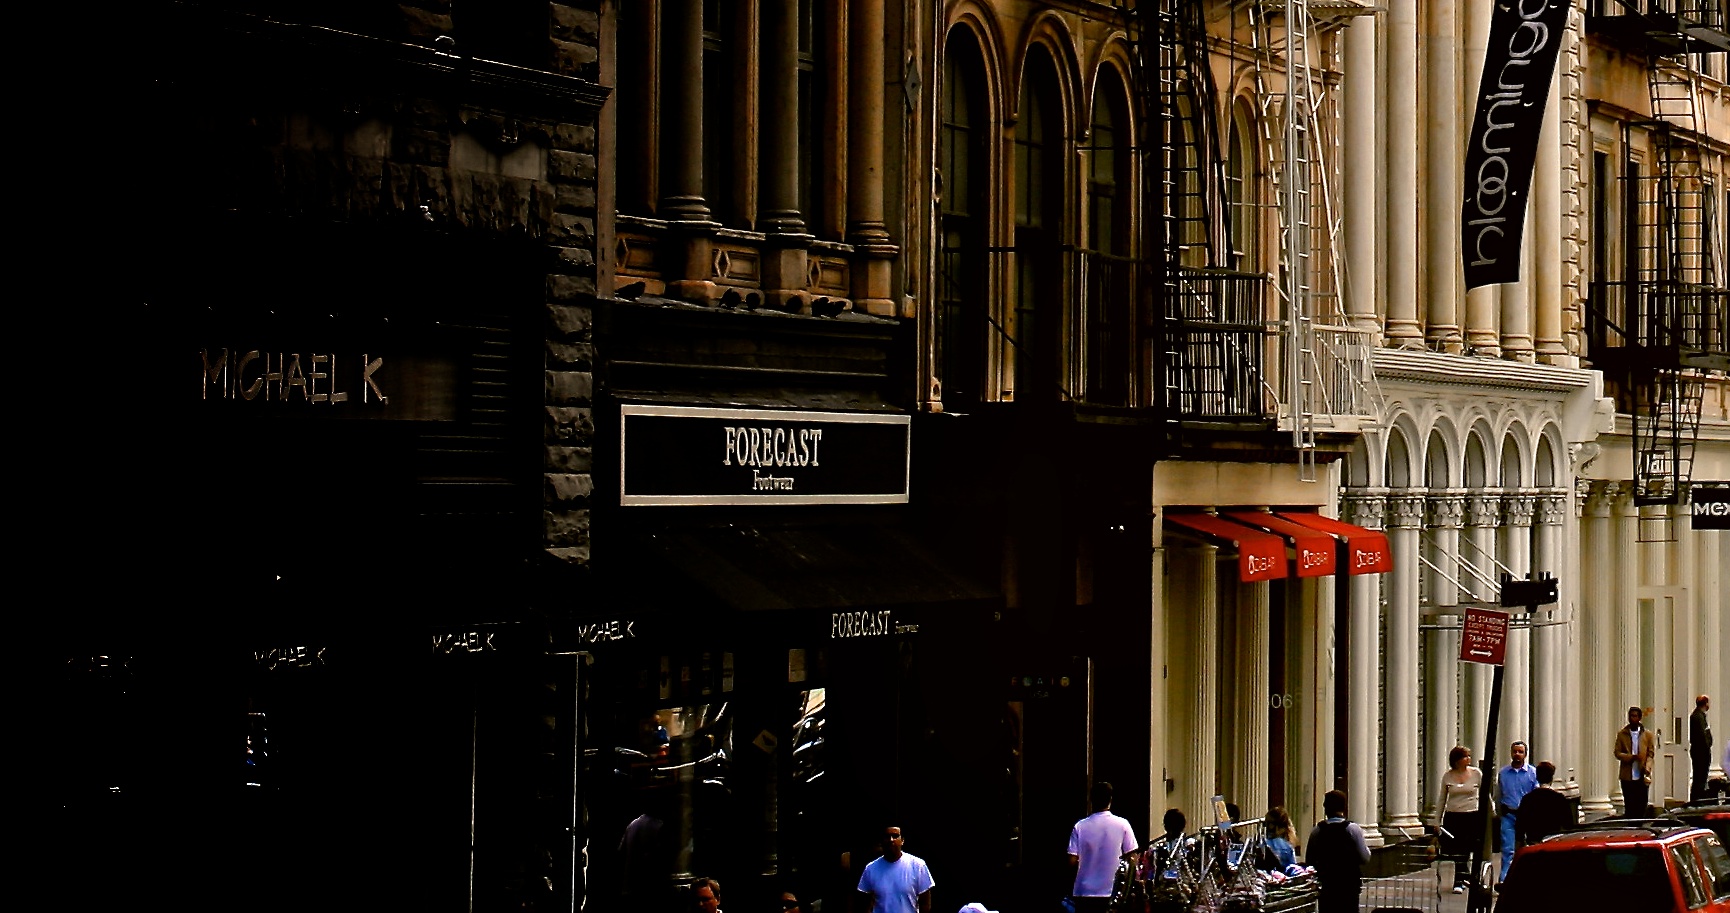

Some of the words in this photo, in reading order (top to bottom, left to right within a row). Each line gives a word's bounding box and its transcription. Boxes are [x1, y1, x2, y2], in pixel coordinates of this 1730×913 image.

[200, 347, 348, 406] MICHAEL
[362, 353, 390, 406] K
[723, 426, 823, 468] FORECAST
[751, 469, 795, 491] Footwear
[831, 609, 892, 639] FORECAST
